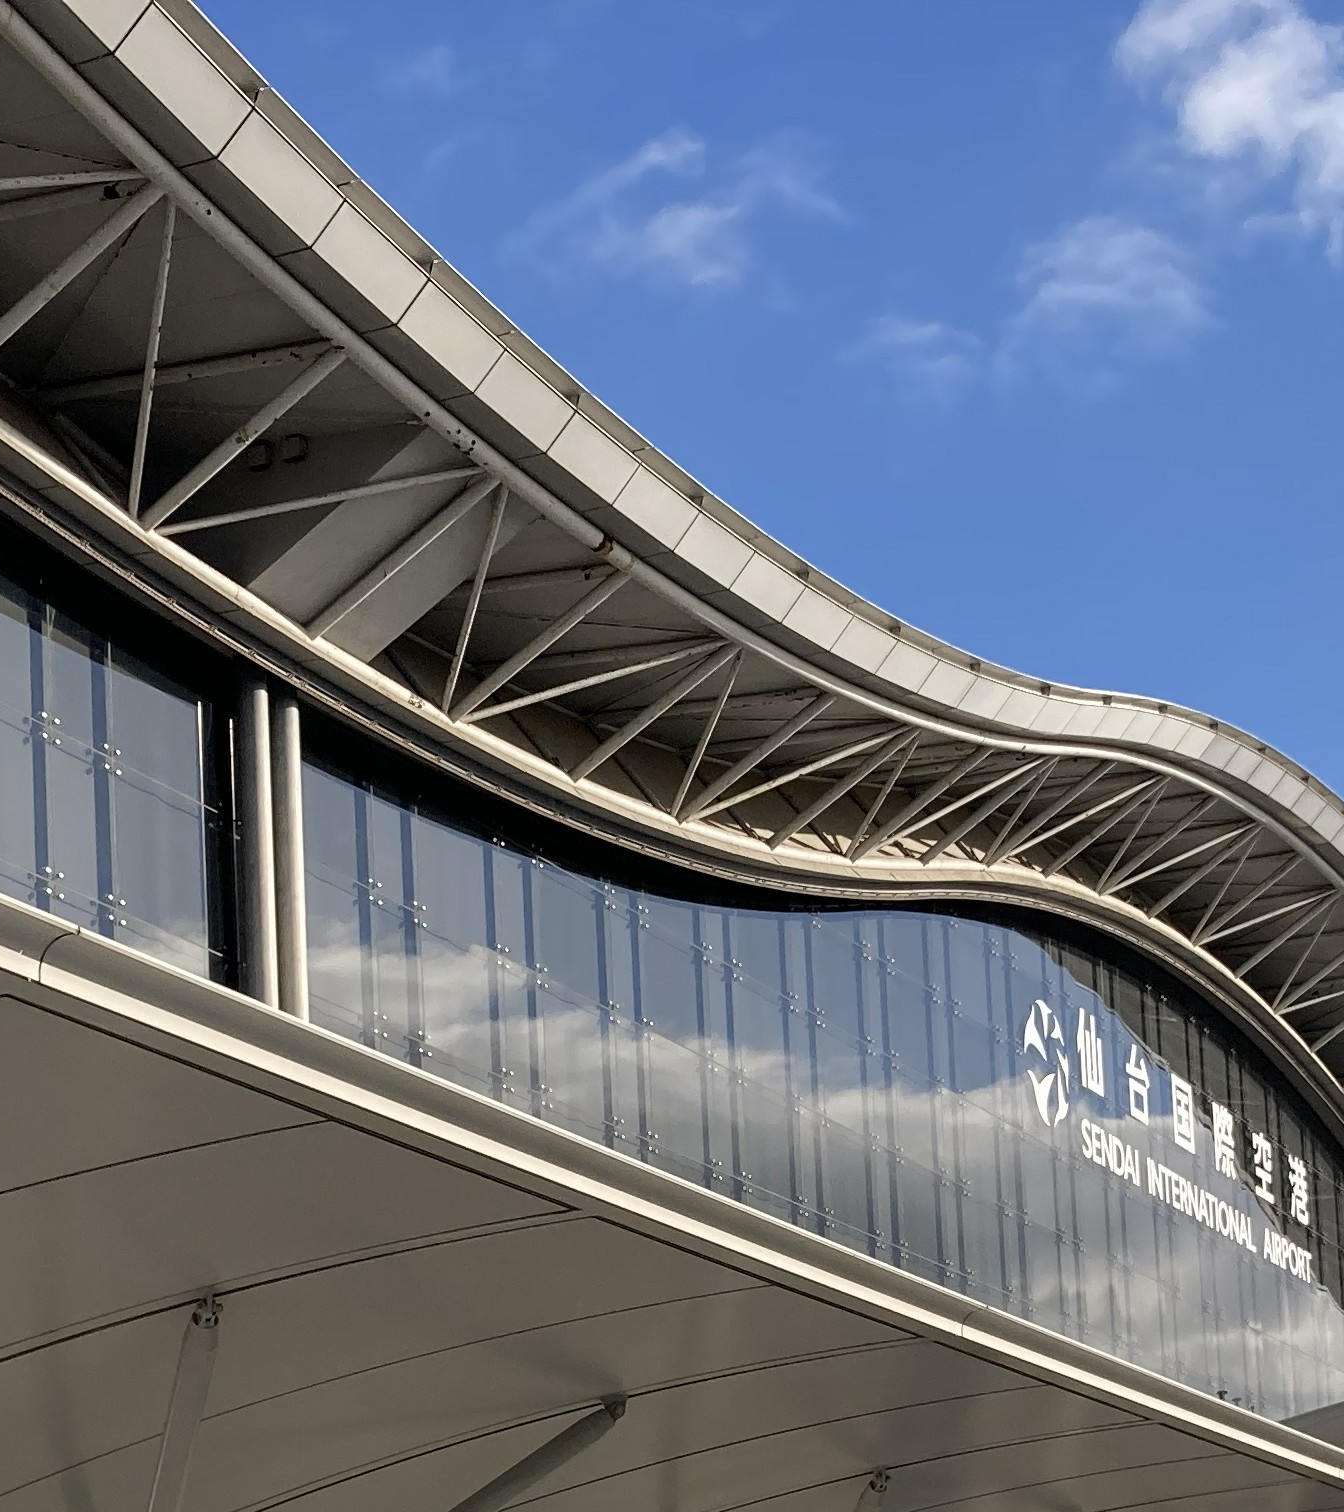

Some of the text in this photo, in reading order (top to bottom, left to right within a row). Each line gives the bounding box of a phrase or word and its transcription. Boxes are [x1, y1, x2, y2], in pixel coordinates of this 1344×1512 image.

[1077, 1007, 1310, 1225] 仙台国際空港
[1081, 1118, 1313, 1284] SENDAI INTERNATIONAL AIRPORT
